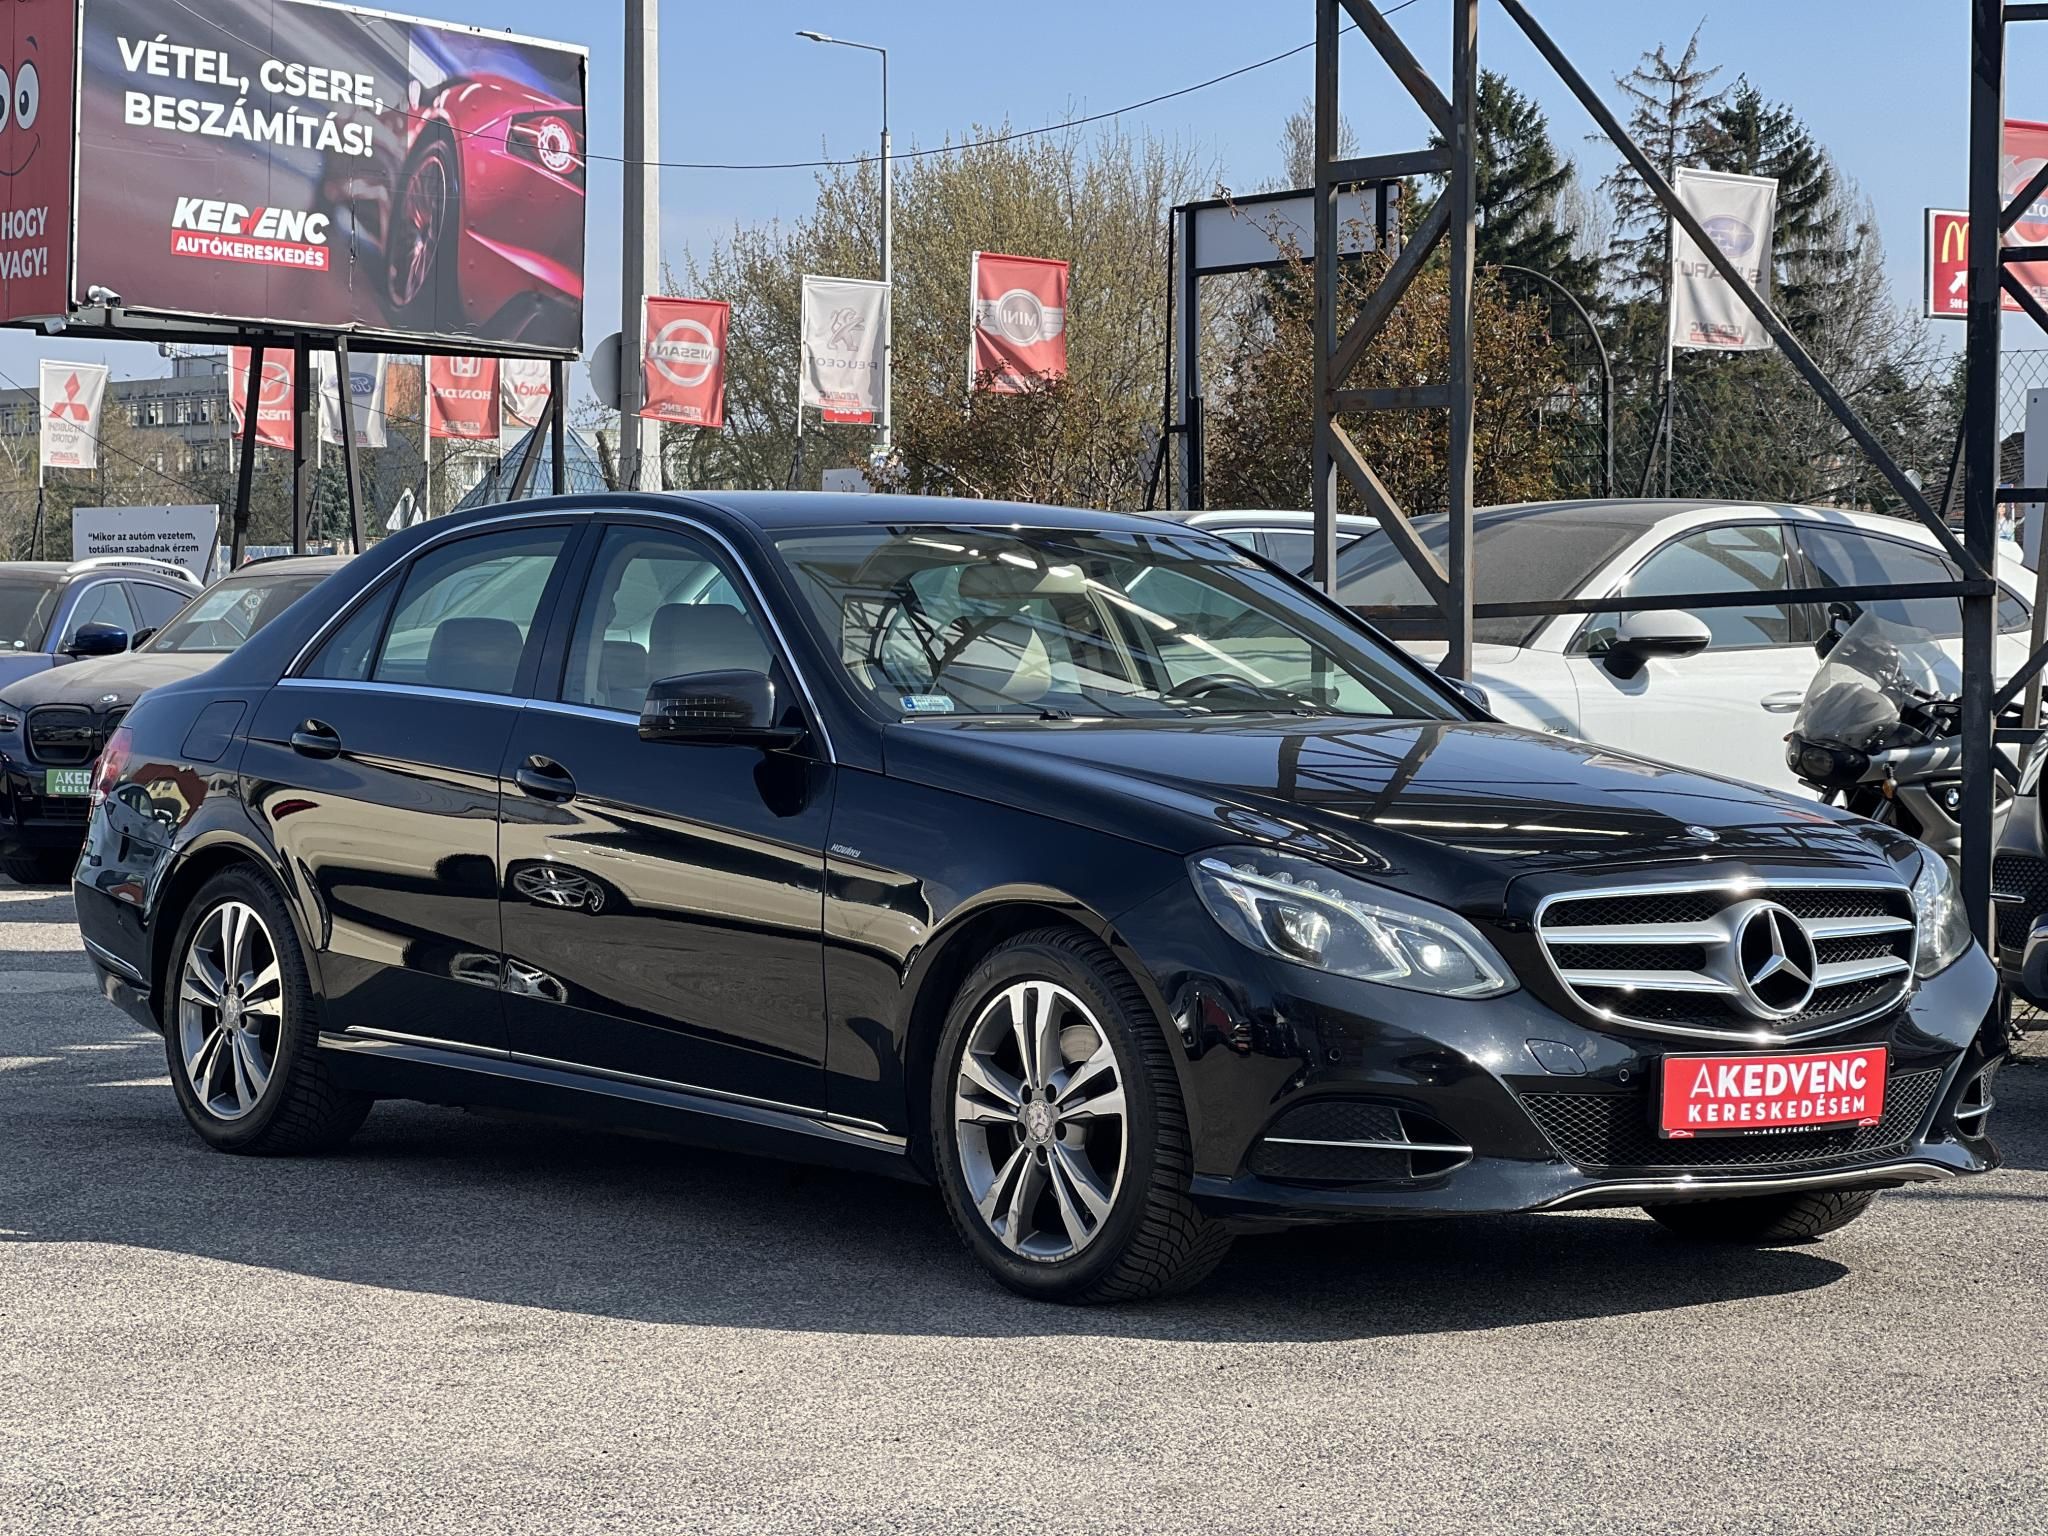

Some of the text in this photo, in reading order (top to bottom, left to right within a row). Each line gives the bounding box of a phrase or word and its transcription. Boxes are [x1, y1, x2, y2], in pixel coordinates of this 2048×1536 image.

[117, 34, 384, 115] VÉTEL, CSERE,
[125, 91, 374, 158] BESZÁMÍTÁS!
[1, 206, 49, 240] HOGY
[171, 197, 330, 245] KEDVENC
[0, 246, 48, 280] VAGY!
[175, 236, 325, 267] AUTÓKERESKEDÉS
[88, 543, 199, 554] totálisan szabadnak érzem
[117, 533, 127, 541] az
[129, 531, 156, 540] autóm
[157, 532, 196, 541] vezetem,
[1688, 1094, 1865, 1122] KERESKEDÉSEM
